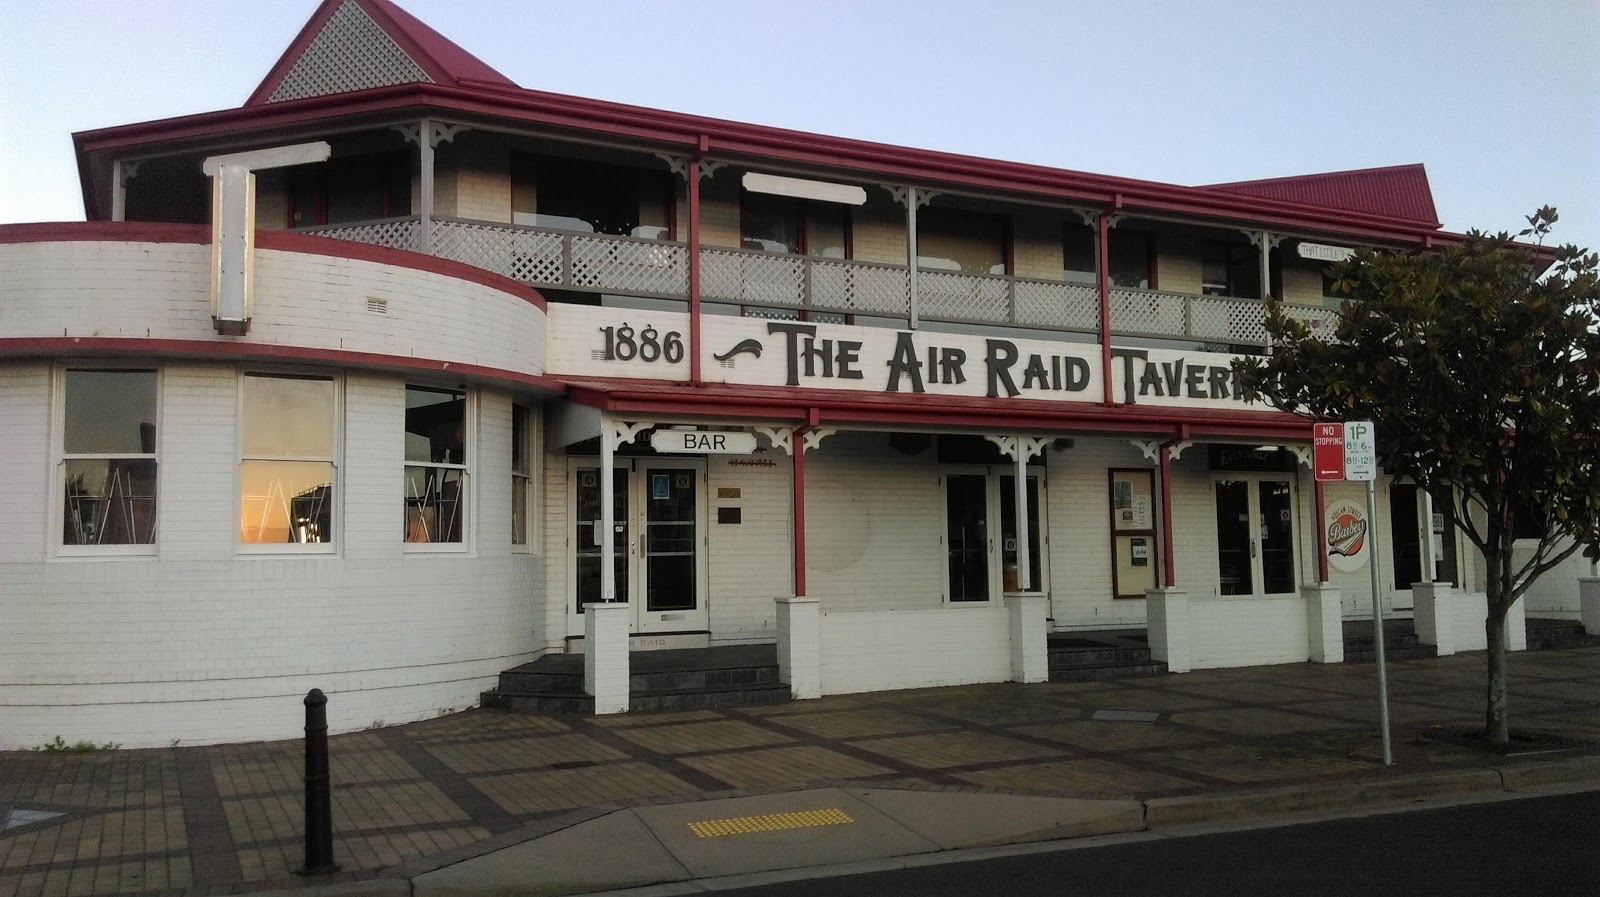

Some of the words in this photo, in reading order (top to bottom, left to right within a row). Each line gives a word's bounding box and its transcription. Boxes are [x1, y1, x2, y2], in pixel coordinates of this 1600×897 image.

[1301, 244, 1319, 257] THAT
[599, 322, 685, 364] 1886
[767, 322, 864, 386] THE
[886, 331, 968, 393] AIR
[984, 338, 1091, 398] RAID
[1322, 426, 1335, 436] NO
[1350, 426, 1367, 440] 1P
[684, 433, 726, 450] BAR
[1315, 437, 1343, 446] STOPPING
